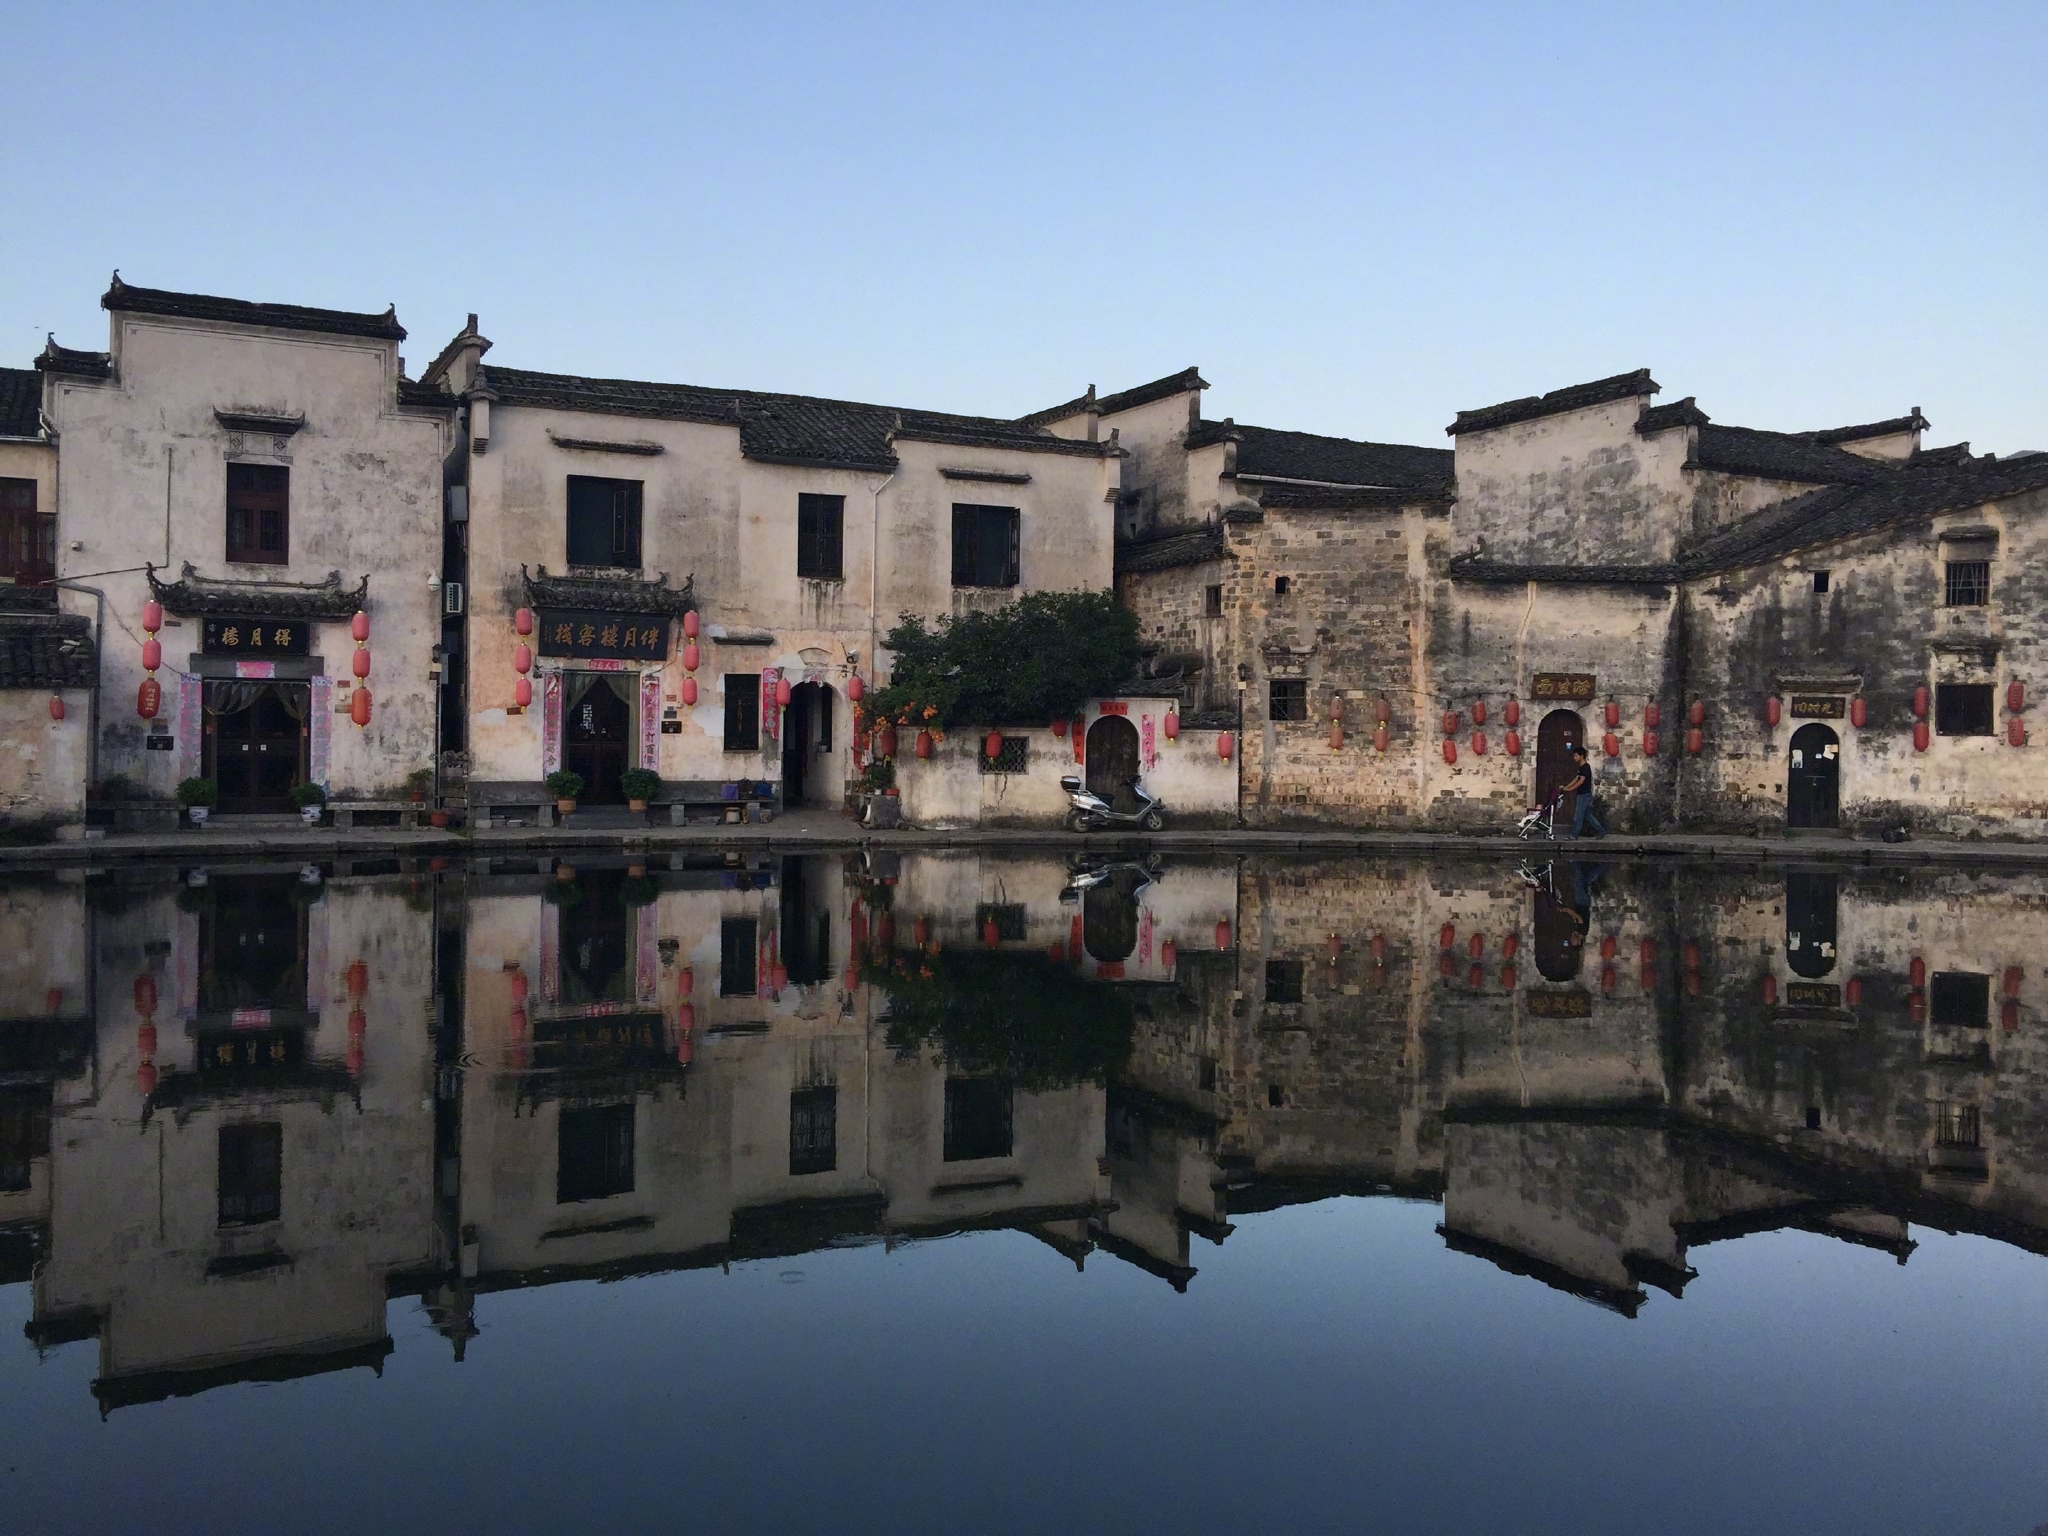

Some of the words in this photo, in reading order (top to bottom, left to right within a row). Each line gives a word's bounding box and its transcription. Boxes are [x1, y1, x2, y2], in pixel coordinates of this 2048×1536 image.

[221, 626, 292, 647] 得月楼
[555, 622, 659, 651] 伴月楼客栈
